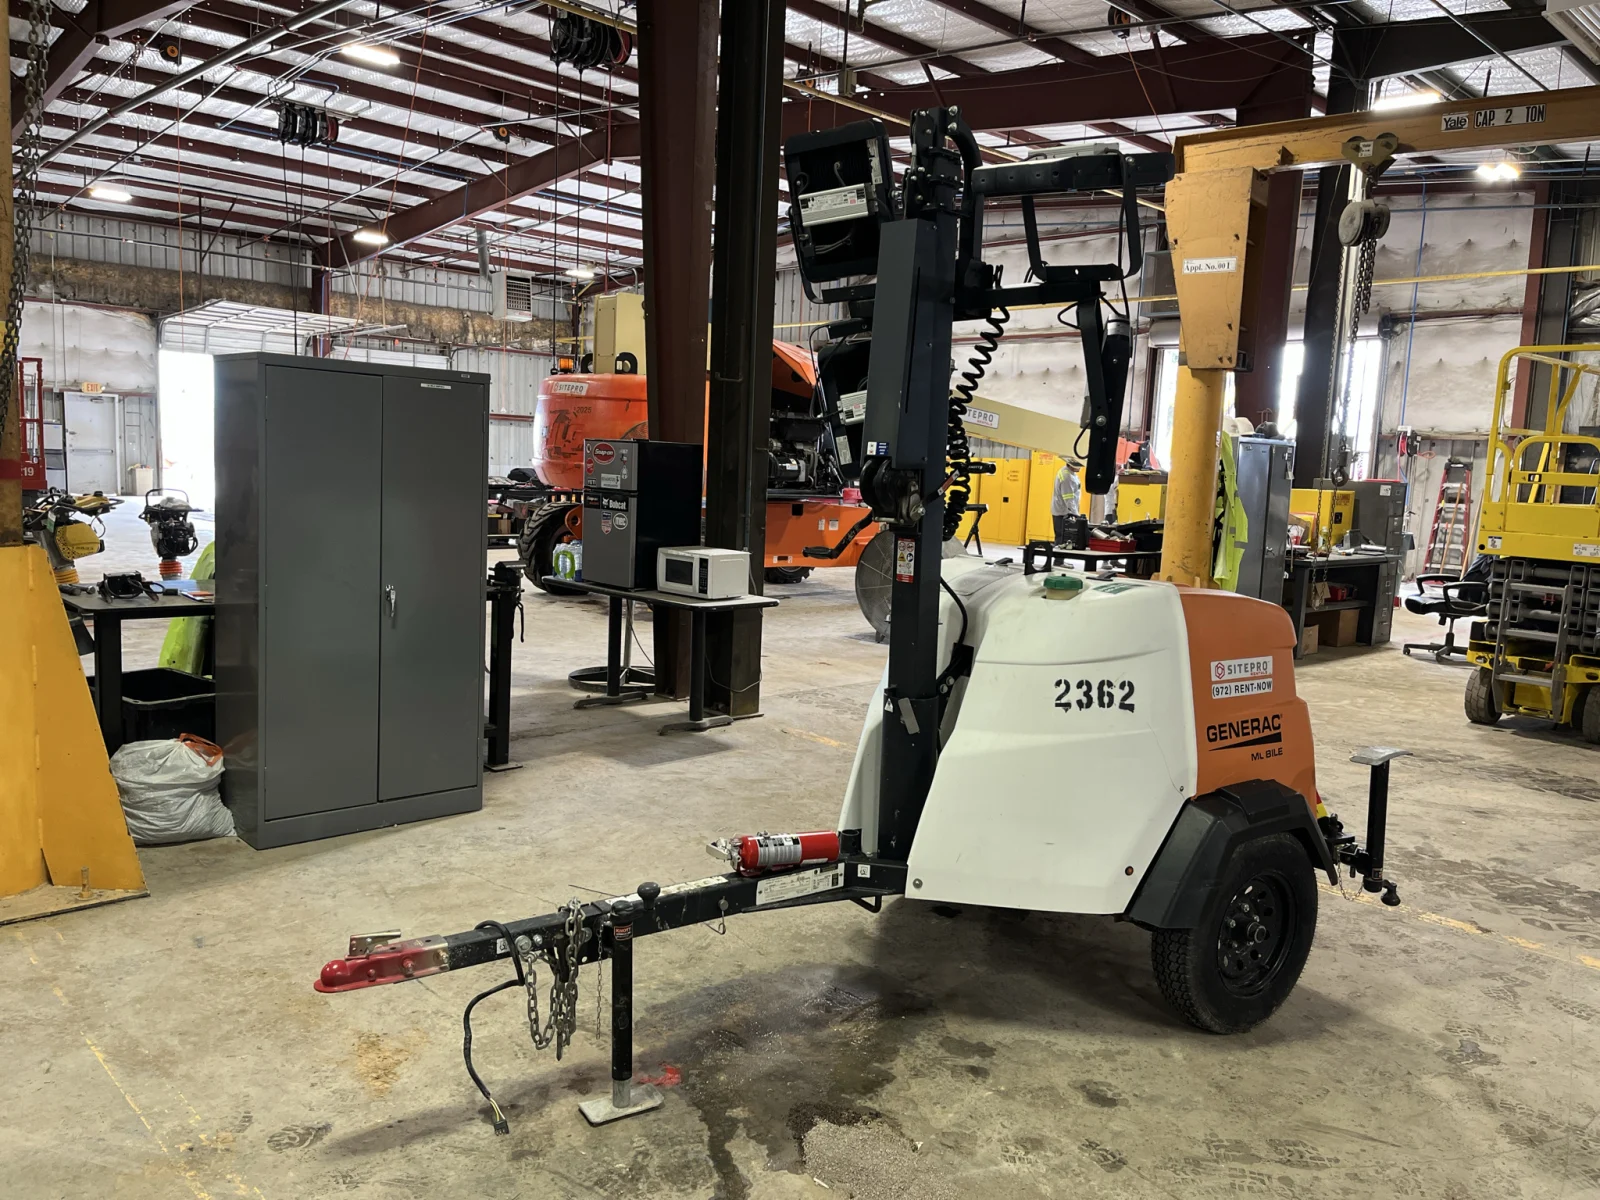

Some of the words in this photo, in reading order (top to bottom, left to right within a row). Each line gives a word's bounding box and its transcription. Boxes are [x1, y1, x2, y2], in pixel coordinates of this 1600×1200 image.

[1443, 116, 1467, 128] Yale
[1475, 110, 1496, 128] CAP.
[1505, 109, 1513, 123] 2
[1526, 105, 1545, 122] TON
[1185, 264, 1203, 273] Appl.
[86, 383, 99, 391] EXIT
[559, 384, 584, 392] SITEPRO
[967, 408, 994, 423] TEPRO
[594, 448, 614, 456] Snap-on
[609, 499, 627, 510] Bobcat
[1227, 660, 1268, 675] SITEPRO
[1054, 679, 1135, 711] 2362
[1212, 684, 1232, 697] (972)
[1234, 681, 1272, 694] RENT-NOW
[1206, 714, 1281, 742] GENERAC
